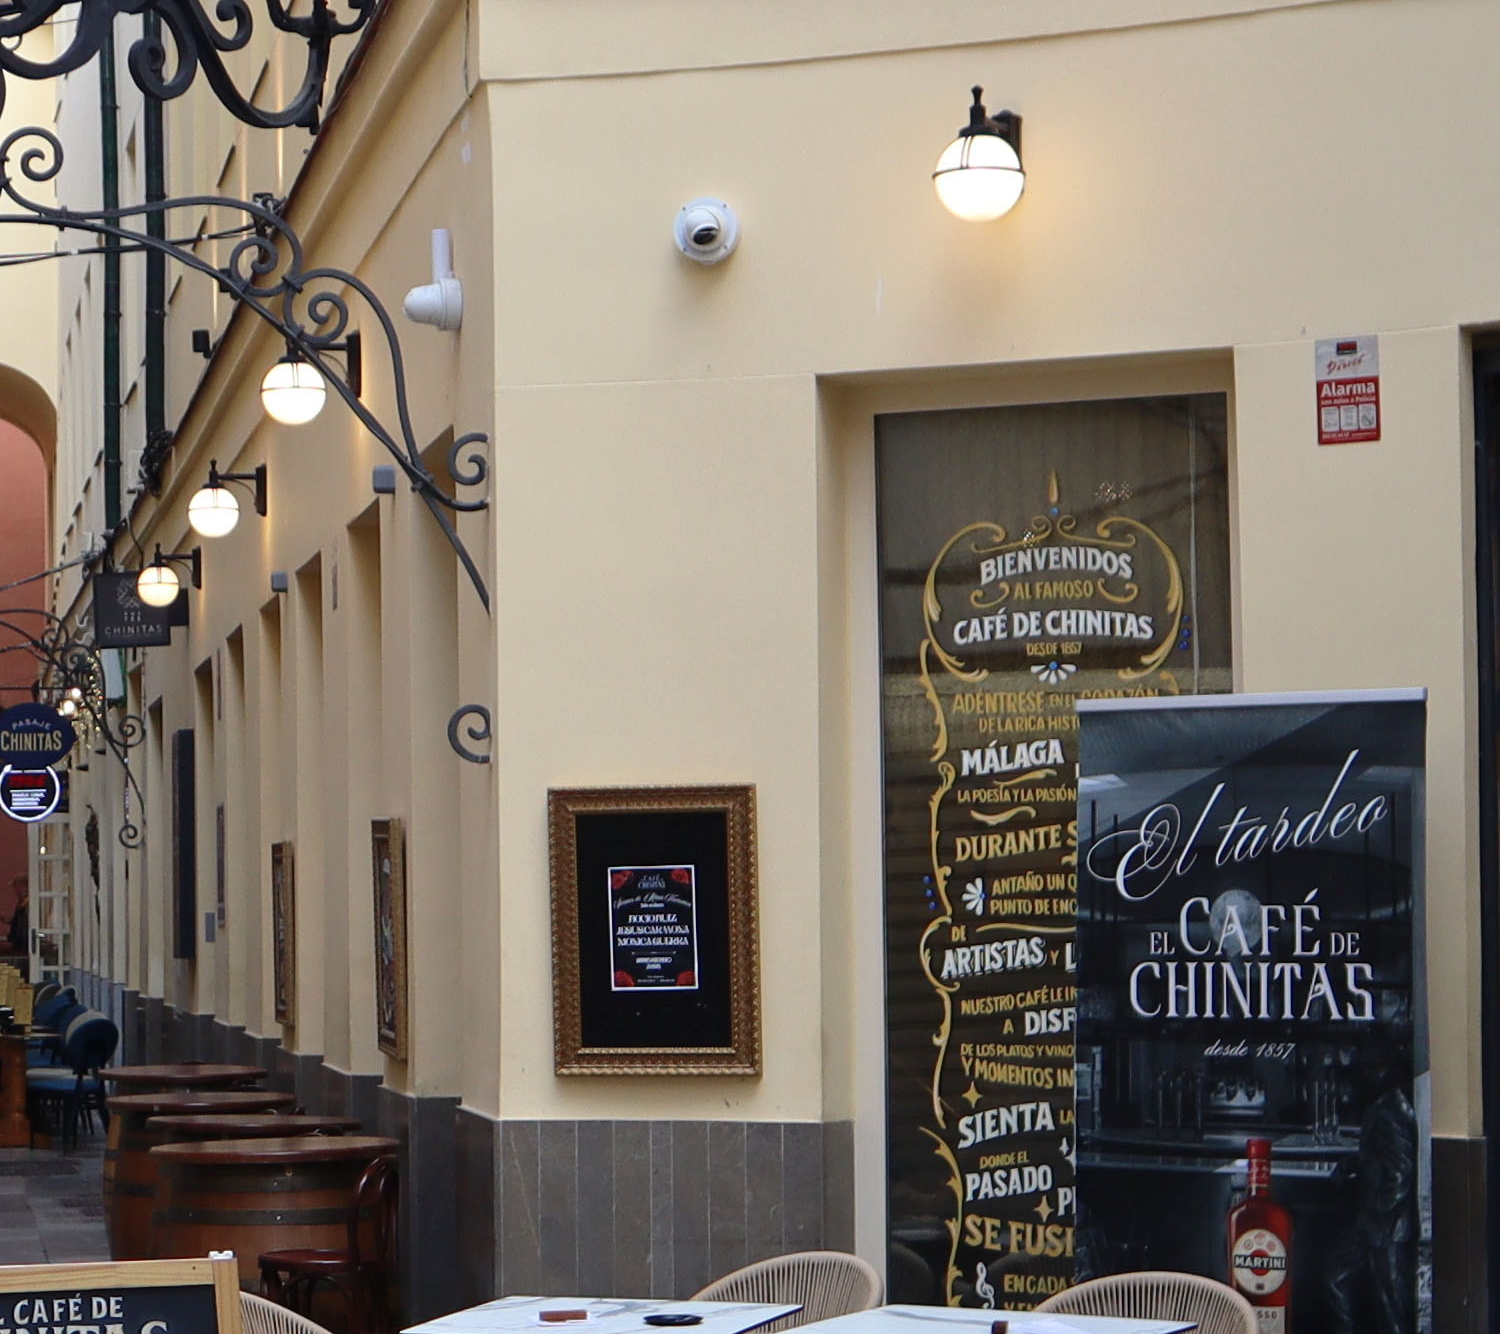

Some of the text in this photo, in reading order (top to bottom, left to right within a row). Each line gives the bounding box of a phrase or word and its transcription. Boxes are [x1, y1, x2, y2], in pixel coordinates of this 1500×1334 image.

[1321, 381, 1375, 398] Alarma
[980, 545, 1134, 586] BIENVENIDOS
[1013, 579, 1094, 600] AL FAMOSO
[105, 624, 162, 635] CHINITAS
[953, 606, 1154, 645] CAFÉ DE CHINITAS
[12, 718, 52, 730] PASAJE
[1015, 716, 1045, 732] RICA
[0, 731, 62, 751] CHINITAS
[961, 737, 1065, 777] MÁLAGA
[1036, 784, 1076, 801] PASIÓN
[1087, 748, 1388, 901] El tardeo
[955, 824, 1062, 862] DURANTE
[992, 871, 1065, 896] ANTAÑO UN
[990, 899, 1050, 916] PUNTO DE
[951, 925, 967, 942] DE
[1150, 888, 1360, 956] EL CAFÉ DE
[941, 936, 1048, 980] ARTISTAS
[961, 984, 1050, 1015] NUESTRO CAFÉ
[1129, 961, 1376, 1020] CHINITAS
[976, 1043, 1035, 1058] LOS PLATOS
[1203, 1039, 1296, 1060] desde 1857
[975, 1059, 1054, 1090] MOMENTOS
[957, 1101, 1056, 1150] SIENTA
[980, 1152, 1016, 1170] DONDE
[965, 1164, 1053, 1203] PASADO
[964, 1214, 1002, 1251] SE
[1234, 1255, 1286, 1269] MARTINI
[1004, 1274, 1067, 1294] EN CADA
[13, 1292, 83, 1325] CAFÉ
[92, 1296, 124, 1319] DE
